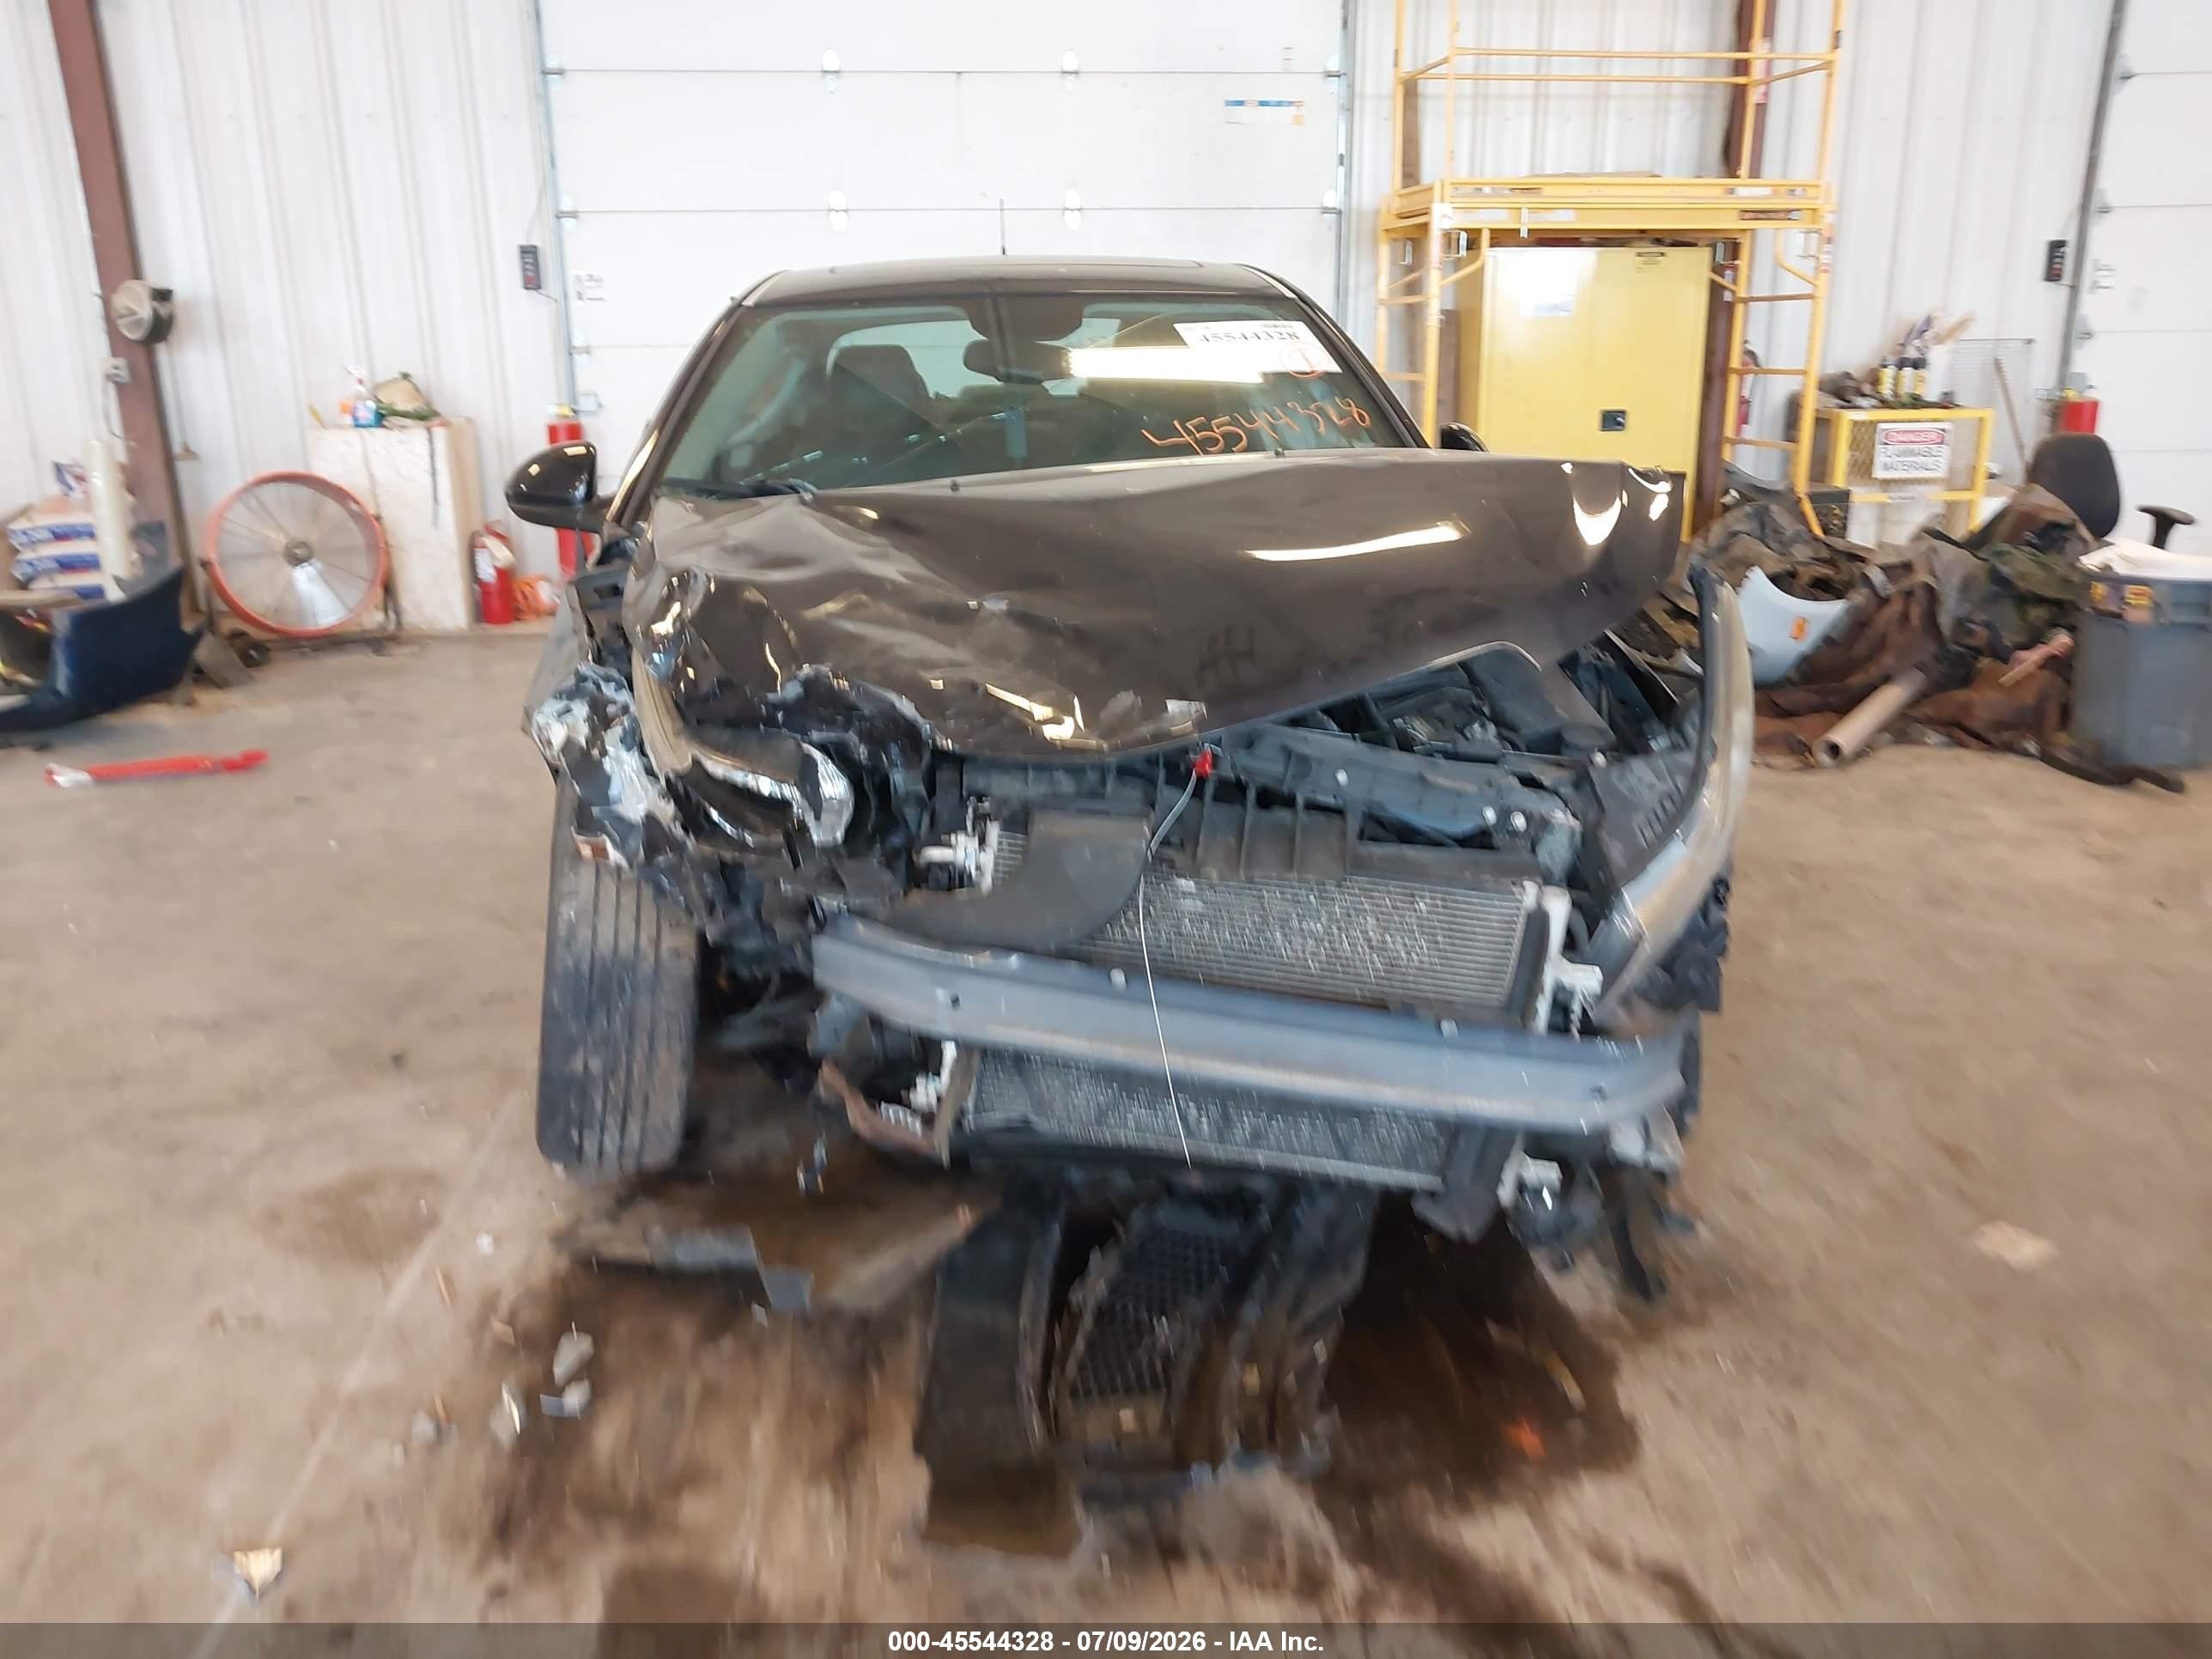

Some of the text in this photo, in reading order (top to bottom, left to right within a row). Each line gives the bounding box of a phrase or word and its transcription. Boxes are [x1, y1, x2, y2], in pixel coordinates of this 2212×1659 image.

[1199, 330, 1301, 343] 45544328
[1140, 396, 1371, 456] 45544328
[1886, 432, 1942, 443] DANGER
[1880, 446, 1944, 459] FLAMMABLE
[1881, 459, 1943, 472] MATERIALS
